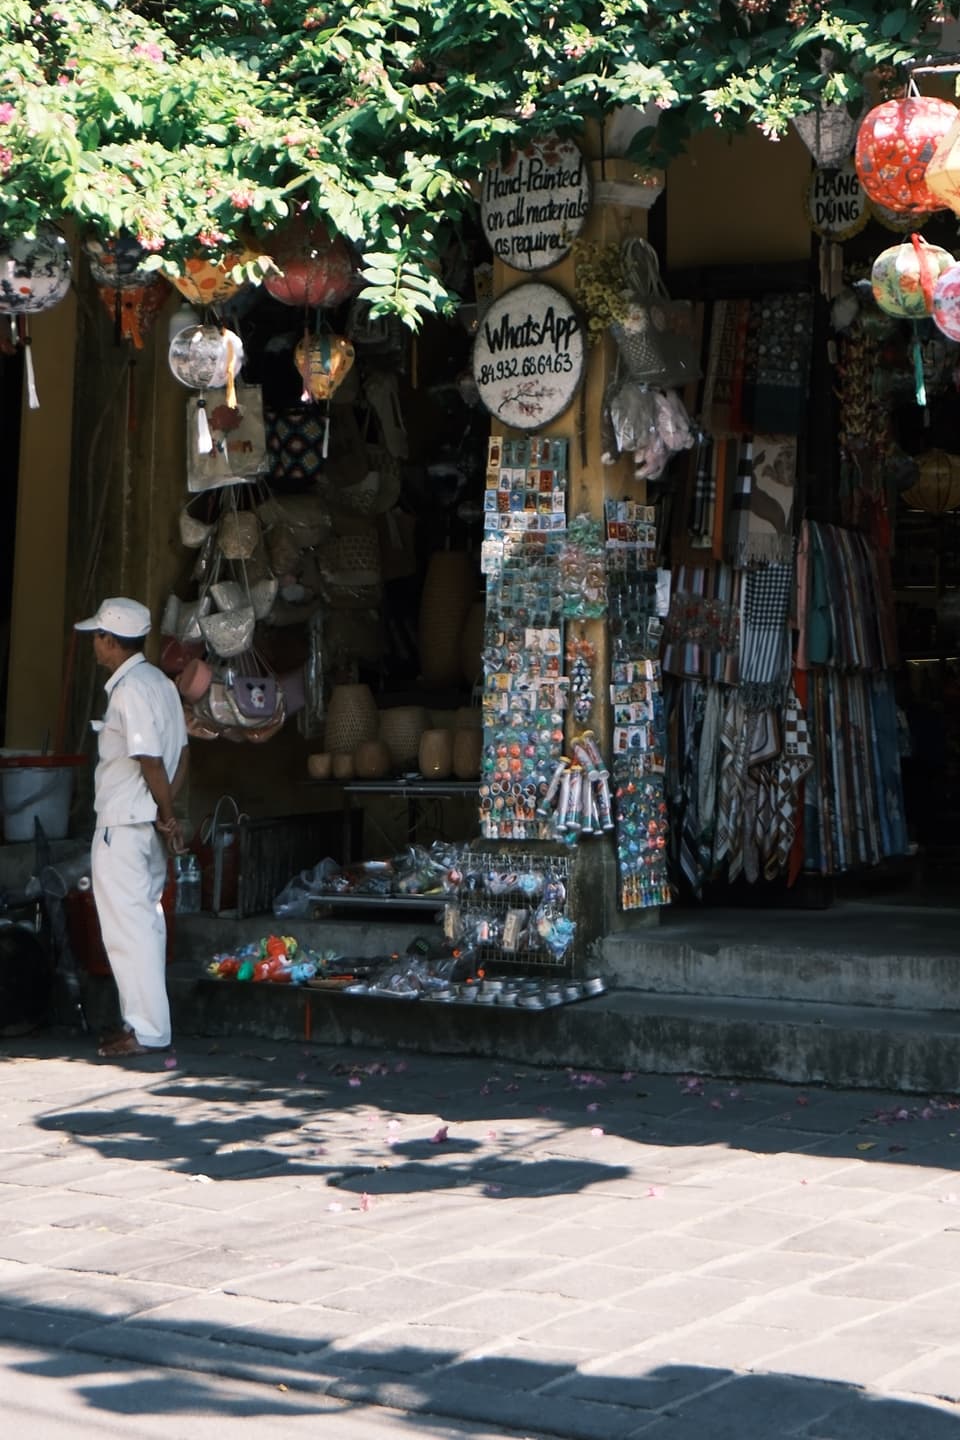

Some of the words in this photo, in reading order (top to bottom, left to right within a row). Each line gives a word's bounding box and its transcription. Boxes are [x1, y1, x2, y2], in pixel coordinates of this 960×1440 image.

[487, 156, 583, 203] Hand-Painted
[487, 210, 504, 232] on
[507, 197, 525, 229] all
[527, 189, 589, 225] materials
[495, 237, 511, 256] as
[485, 306, 579, 354] WhatsApp
